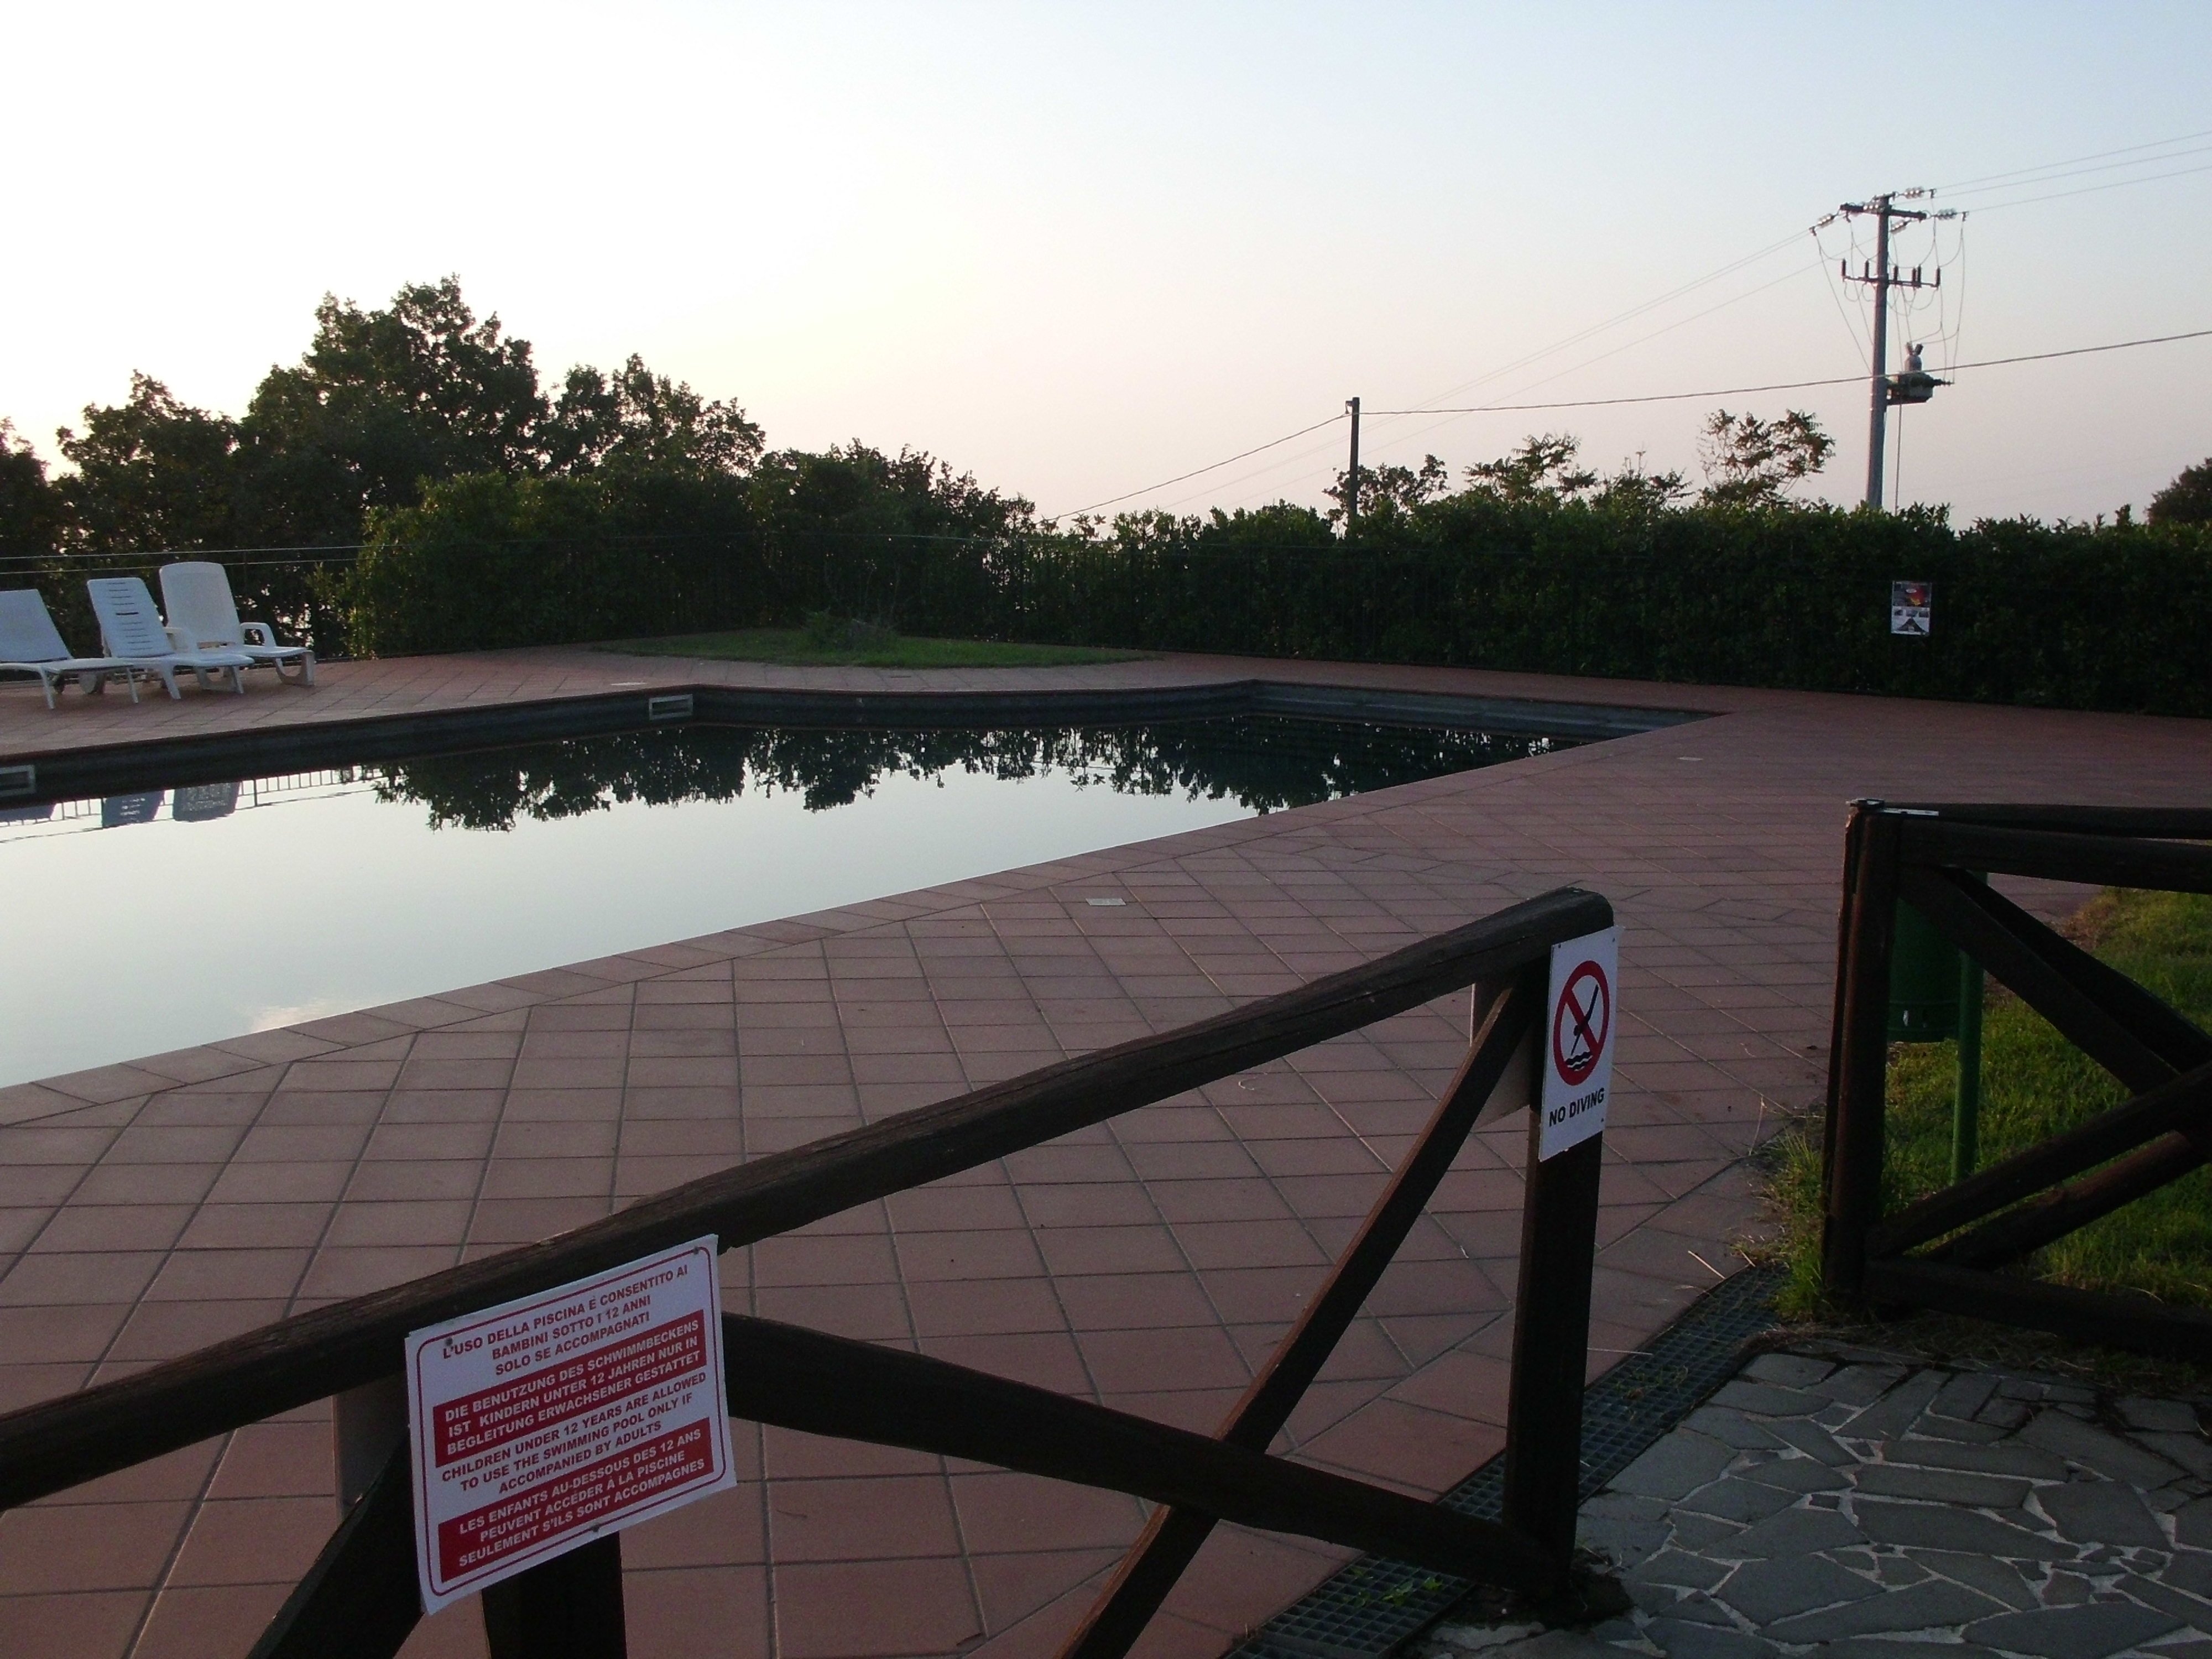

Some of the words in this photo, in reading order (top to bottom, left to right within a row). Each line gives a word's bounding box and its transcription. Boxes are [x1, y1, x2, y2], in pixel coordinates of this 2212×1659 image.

[1549, 1106, 1566, 1127] NO
[1569, 1088, 1604, 1118] DIVING
[443, 1337, 483, 1359] L'USO
[488, 1322, 529, 1344] DELLA
[534, 1303, 585, 1329] PISCINA
[600, 1270, 674, 1306] CONSENTITO
[676, 1265, 687, 1277] AI
[492, 1332, 548, 1359] BAMBINI
[552, 1317, 593, 1339] SOTTO
[606, 1307, 619, 1319] 12
[623, 1295, 650, 1314] ANNI
[496, 1355, 530, 1375] SOLO
[535, 1347, 551, 1361] SE
[555, 1312, 649, 1355] ACCOMPAGNATI
[445, 1405, 468, 1422] DIE
[472, 1374, 555, 1412] BENUTZUNG
[559, 1364, 584, 1381] DES
[588, 1320, 698, 1370] SCHWIMMBECKENS
[447, 1415, 534, 1455] BEGLEITUNG
[538, 1378, 632, 1422] ERWACHSENER
[635, 1350, 700, 1383] GESTATTET
[448, 1421, 471, 1438] IST
[479, 1396, 540, 1427] KINDERN
[543, 1379, 586, 1402] UNTER
[591, 1373, 604, 1385] 12
[608, 1353, 655, 1379] JAHREN
[659, 1342, 682, 1359] NUR
[686, 1336, 697, 1349] IN
[442, 1448, 511, 1482] CHILDREN
[515, 1430, 560, 1454] UNDER
[564, 1422, 578, 1435] 12
[582, 1405, 622, 1428] YEARS
[625, 1392, 649, 1412] ARE
[653, 1372, 706, 1402] ALLOWED
[460, 1477, 479, 1491] TO
[483, 1464, 509, 1483] USE
[513, 1453, 539, 1471] THE
[543, 1426, 609, 1460] SWIMMING
[613, 1413, 645, 1433] POOL
[648, 1398, 679, 1418] ONLY
[682, 1392, 693, 1405] IF
[499, 1449, 591, 1494] ACCOMPANIED
[596, 1441, 612, 1455] BY
[615, 1421, 661, 1447] ADULTS
[459, 1525, 539, 1567] SEULEMENT
[542, 1511, 573, 1532] S'ILS
[577, 1495, 611, 1518] SONT
[614, 1458, 705, 1503] ACCOMPAGNES
[460, 1516, 485, 1535] LES
[489, 1490, 549, 1523] ENFANTS
[552, 1457, 630, 1497] AU-DESSOUS
[633, 1446, 657, 1464] DES
[660, 1439, 674, 1453] 12
[677, 1428, 701, 1447] ANS
[480, 1509, 541, 1542] PEUVENT
[619, 1472, 634, 1486] LA
[638, 1451, 685, 1478] PISCINE
